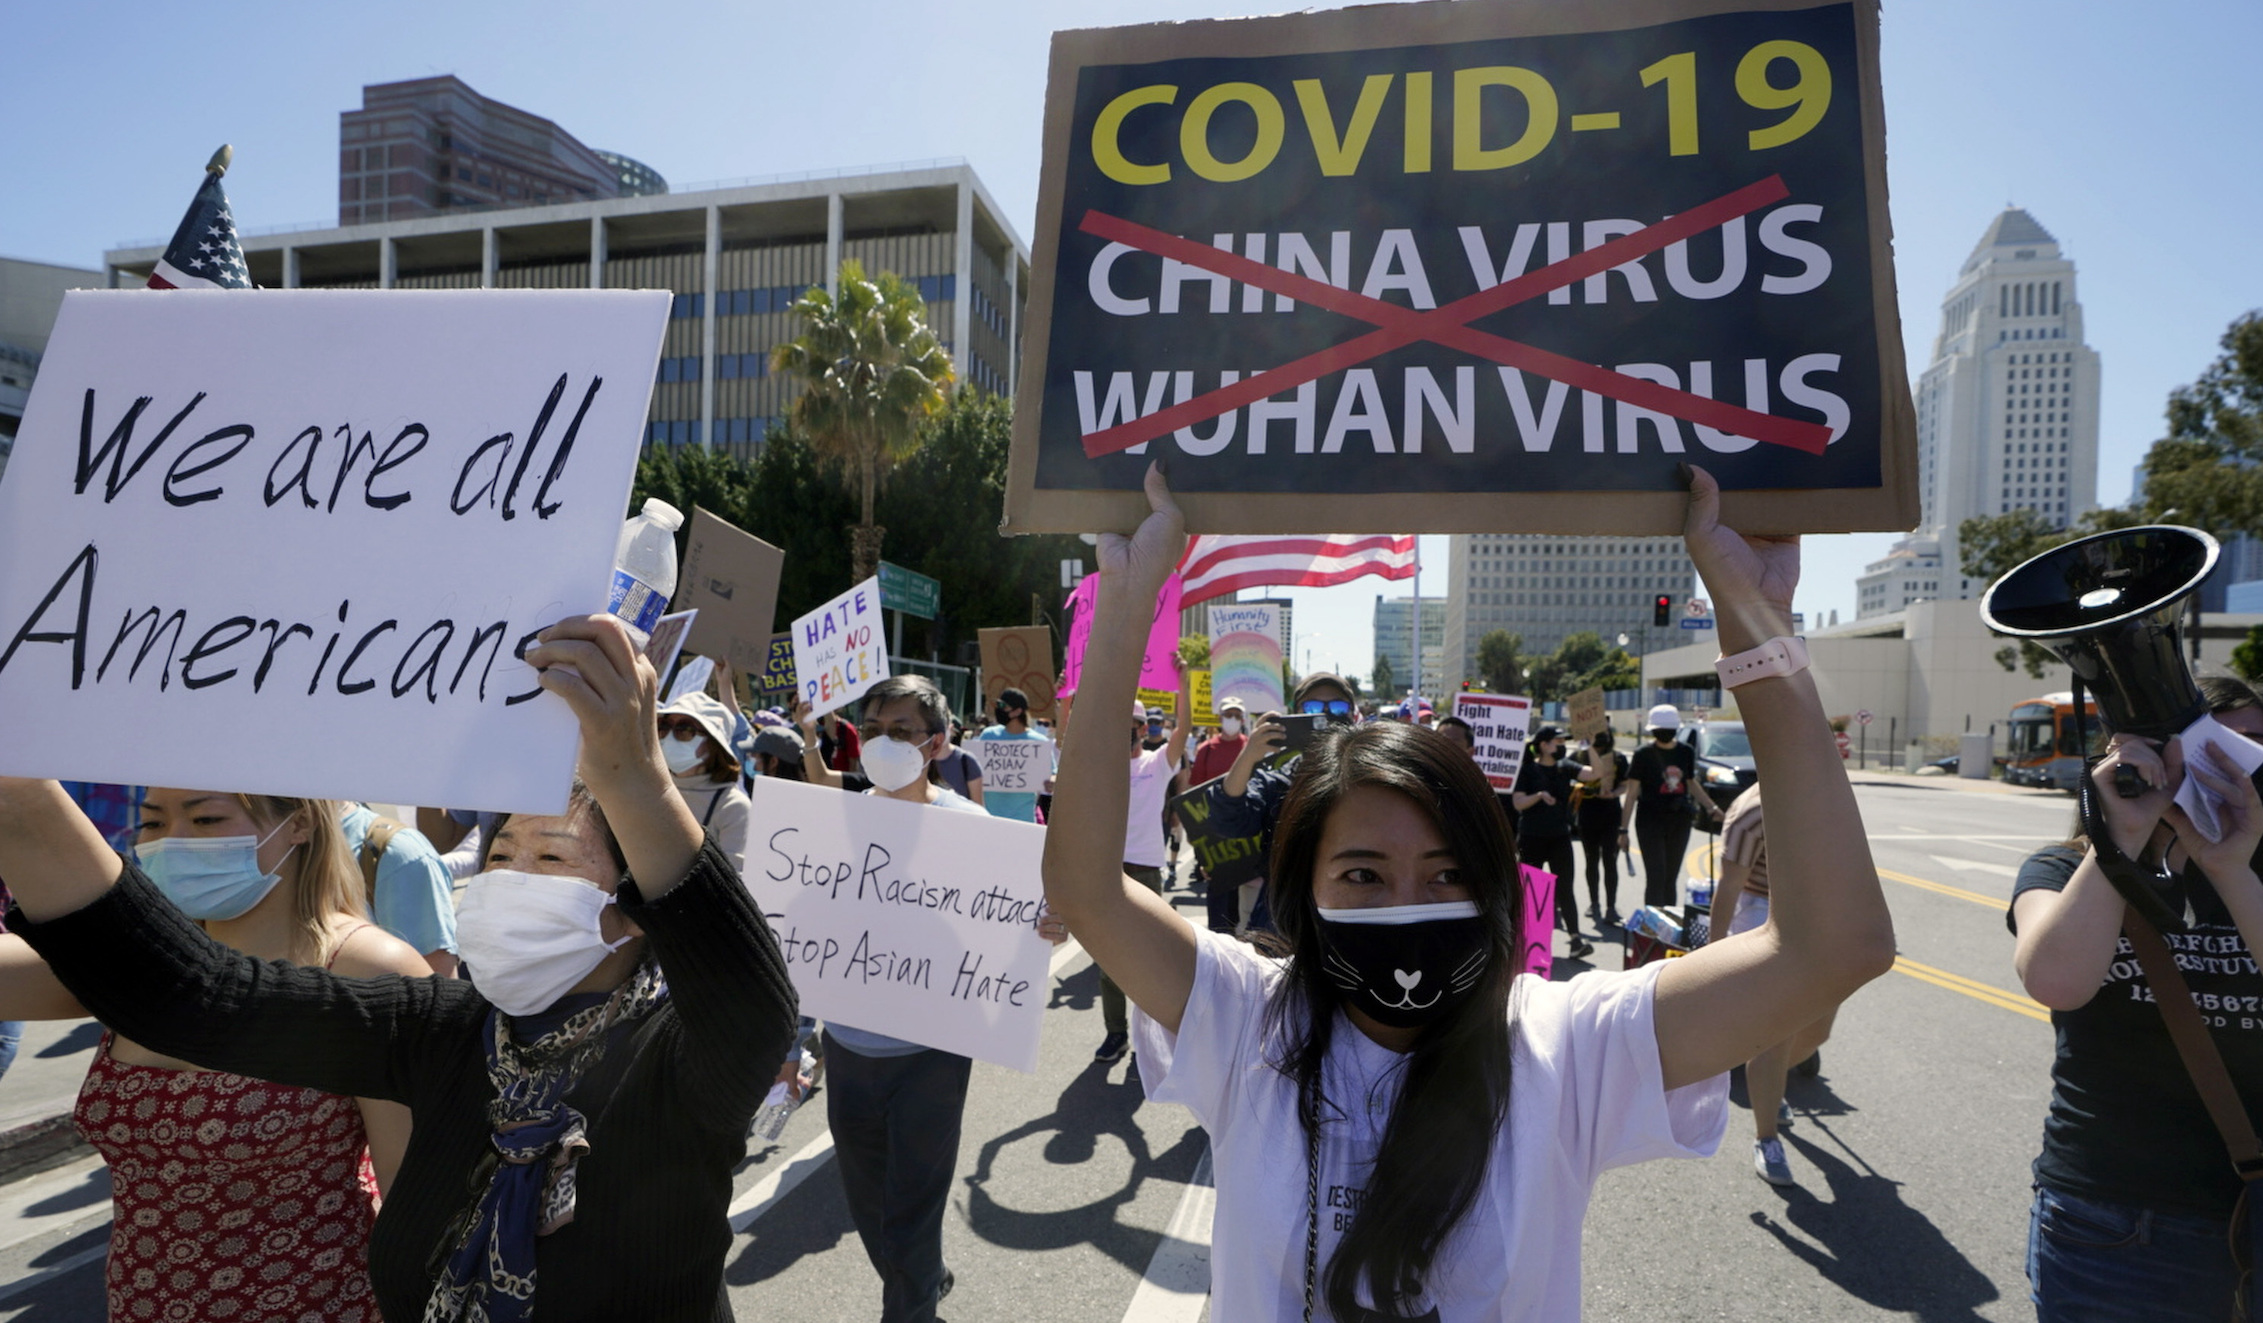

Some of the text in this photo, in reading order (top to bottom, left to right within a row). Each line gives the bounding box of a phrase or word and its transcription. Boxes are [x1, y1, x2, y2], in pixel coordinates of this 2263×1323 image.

[1090, 39, 1833, 186] COVID-19
[1088, 204, 1833, 317] CHINA VIRUS
[1073, 353, 1851, 457] WUHAN VIRUS
[74, 372, 603, 520] We are all
[0, 541, 558, 706] Americans
[806, 591, 867, 647] HATE
[1215, 621, 1263, 637] First
[772, 641, 793, 657] ST
[816, 625, 871, 667] HAS NO
[769, 657, 795, 673] CH
[1458, 703, 1491, 719] Fight
[1577, 706, 1598, 723] NOT
[1471, 722, 1525, 742] ian Hate
[984, 742, 1041, 758] PROTECT
[1488, 746, 1520, 761] Down
[984, 758, 1026, 771] ASIAN
[1477, 761, 1518, 775] rialism
[766, 828, 1048, 930] Stop Racism attack
[845, 930, 931, 991] Asian
[951, 950, 1029, 1006] Hate
